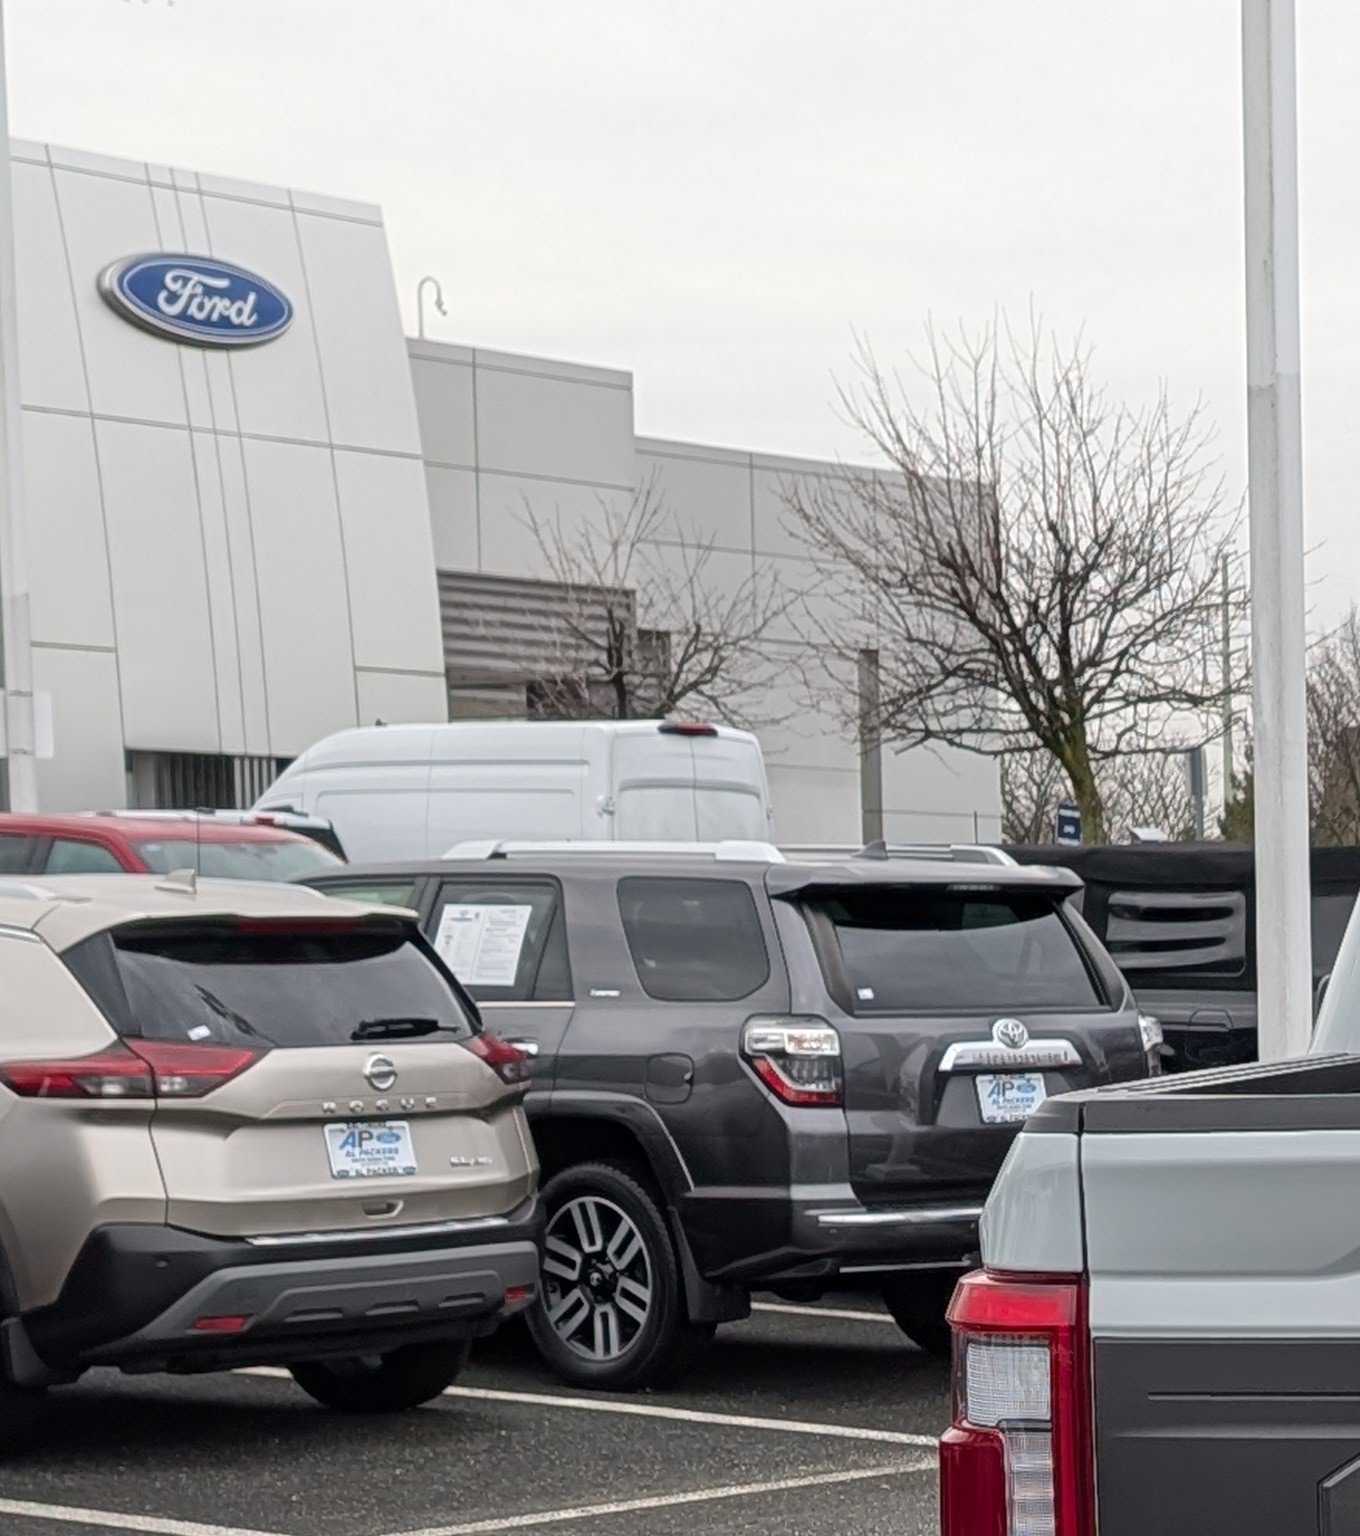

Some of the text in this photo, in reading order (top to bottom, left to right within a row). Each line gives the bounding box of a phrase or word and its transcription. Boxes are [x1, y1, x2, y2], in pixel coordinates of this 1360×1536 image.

[157, 268, 257, 326] Ford
[988, 1081, 1014, 1098] AP
[323, 1097, 436, 1112] ROGUE
[339, 1130, 373, 1149] AP
